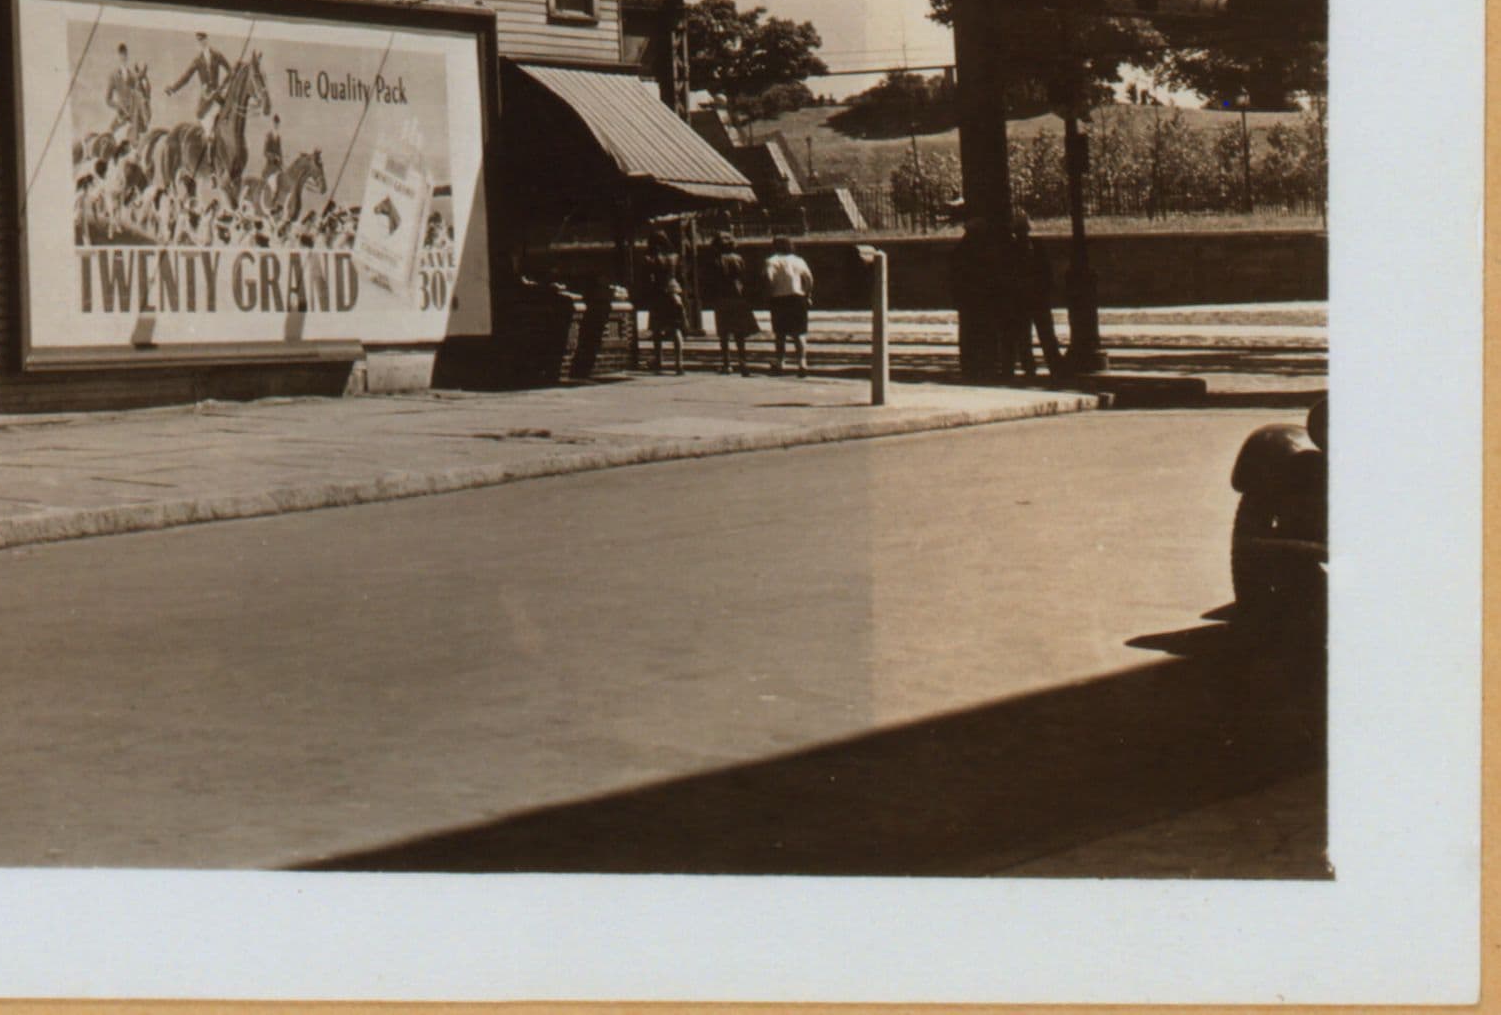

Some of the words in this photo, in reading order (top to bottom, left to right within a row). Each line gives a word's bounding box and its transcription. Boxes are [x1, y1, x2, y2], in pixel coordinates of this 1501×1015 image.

[285, 69, 311, 99] The
[316, 71, 372, 107] Quality
[376, 75, 407, 105] Pack
[75, 249, 220, 313] TWENTY
[231, 250, 358, 313] GRAND
